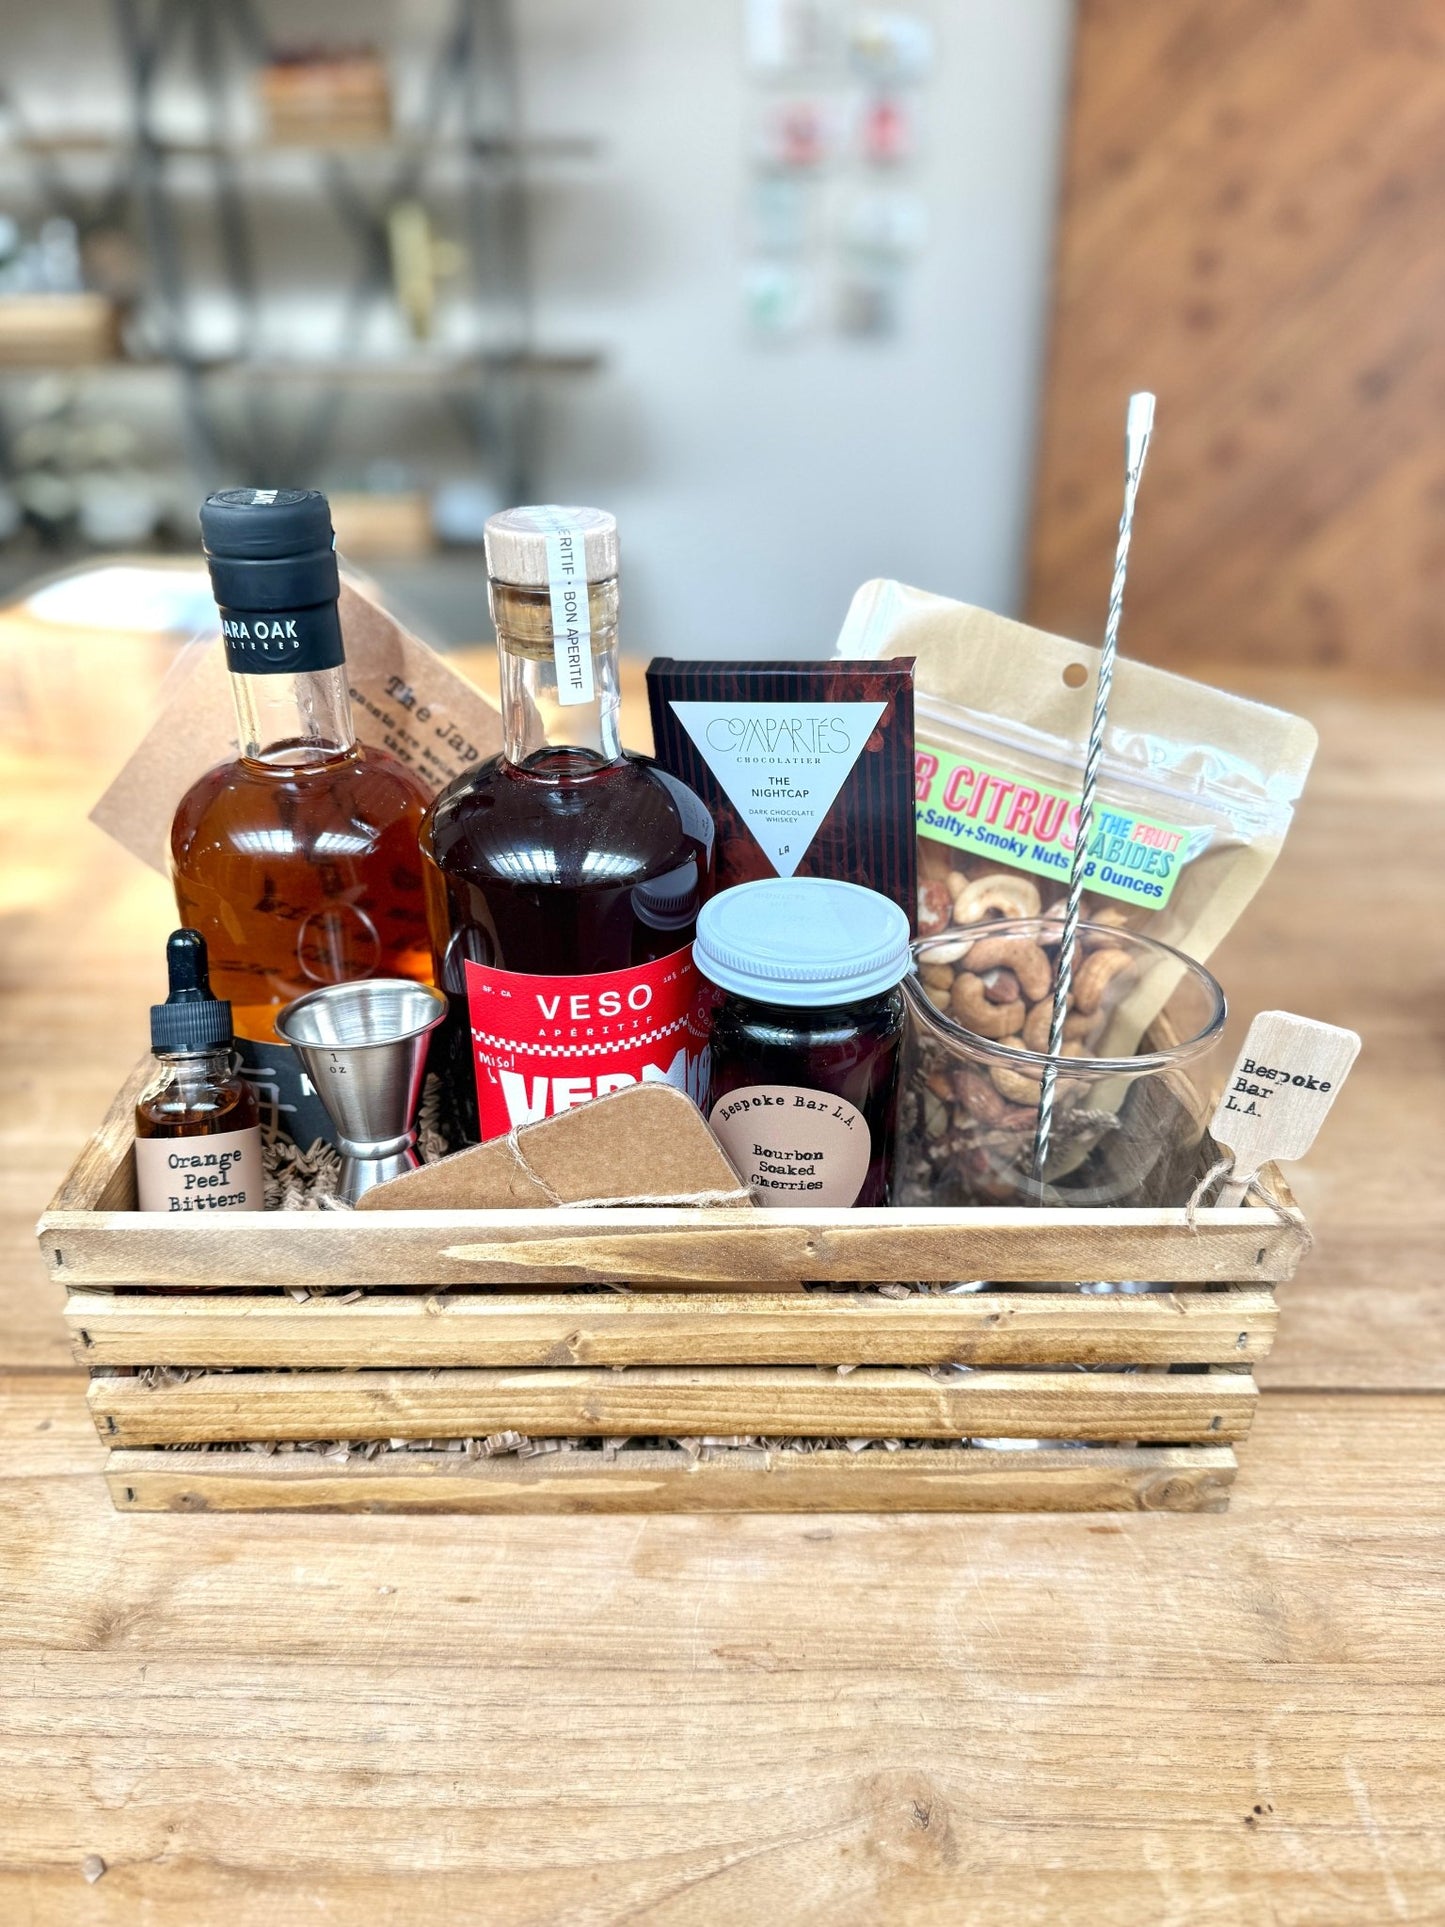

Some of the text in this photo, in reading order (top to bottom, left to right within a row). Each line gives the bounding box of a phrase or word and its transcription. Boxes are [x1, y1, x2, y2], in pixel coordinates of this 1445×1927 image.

[563, 591, 577, 622] BON
[254, 620, 297, 639] OAK
[567, 628, 583, 689] APERITIF
[385, 676, 478, 762] The Jap
[706, 718, 851, 754] COMPARTÉS
[736, 756, 822, 764] CHOCOLATIER
[768, 776, 791, 786] THE
[751, 788, 810, 799] NIGHTCAP
[915, 750, 1093, 852] R CITRUS
[749, 808, 815, 817] DARK CHOCOLATE
[1098, 811, 1184, 853] THE FRUIT
[778, 845, 790, 856] LA
[1031, 844, 1070, 869] Nuts
[1087, 831, 1175, 879] ABIDES
[1084, 861, 1164, 899] 8 Ounces
[501, 989, 512, 998] CA
[536, 983, 653, 1020] VESO
[538, 1014, 653, 1037] APÉRITIF
[330, 1053, 338, 1063] 1
[1240, 1058, 1332, 1093] Bespoke
[1232, 1077, 1274, 1099] Bar
[719, 1095, 856, 1130] Bespoke Bar L.A.
[1225, 1095, 1262, 1118] L.A.
[168, 1148, 243, 1170] Orange
[753, 1144, 824, 1160] Bourbon
[759, 1160, 816, 1175] Soaked
[184, 1170, 229, 1190] Peel
[751, 1174, 823, 1191] Cherries
[168, 1190, 247, 1212] Bitters
